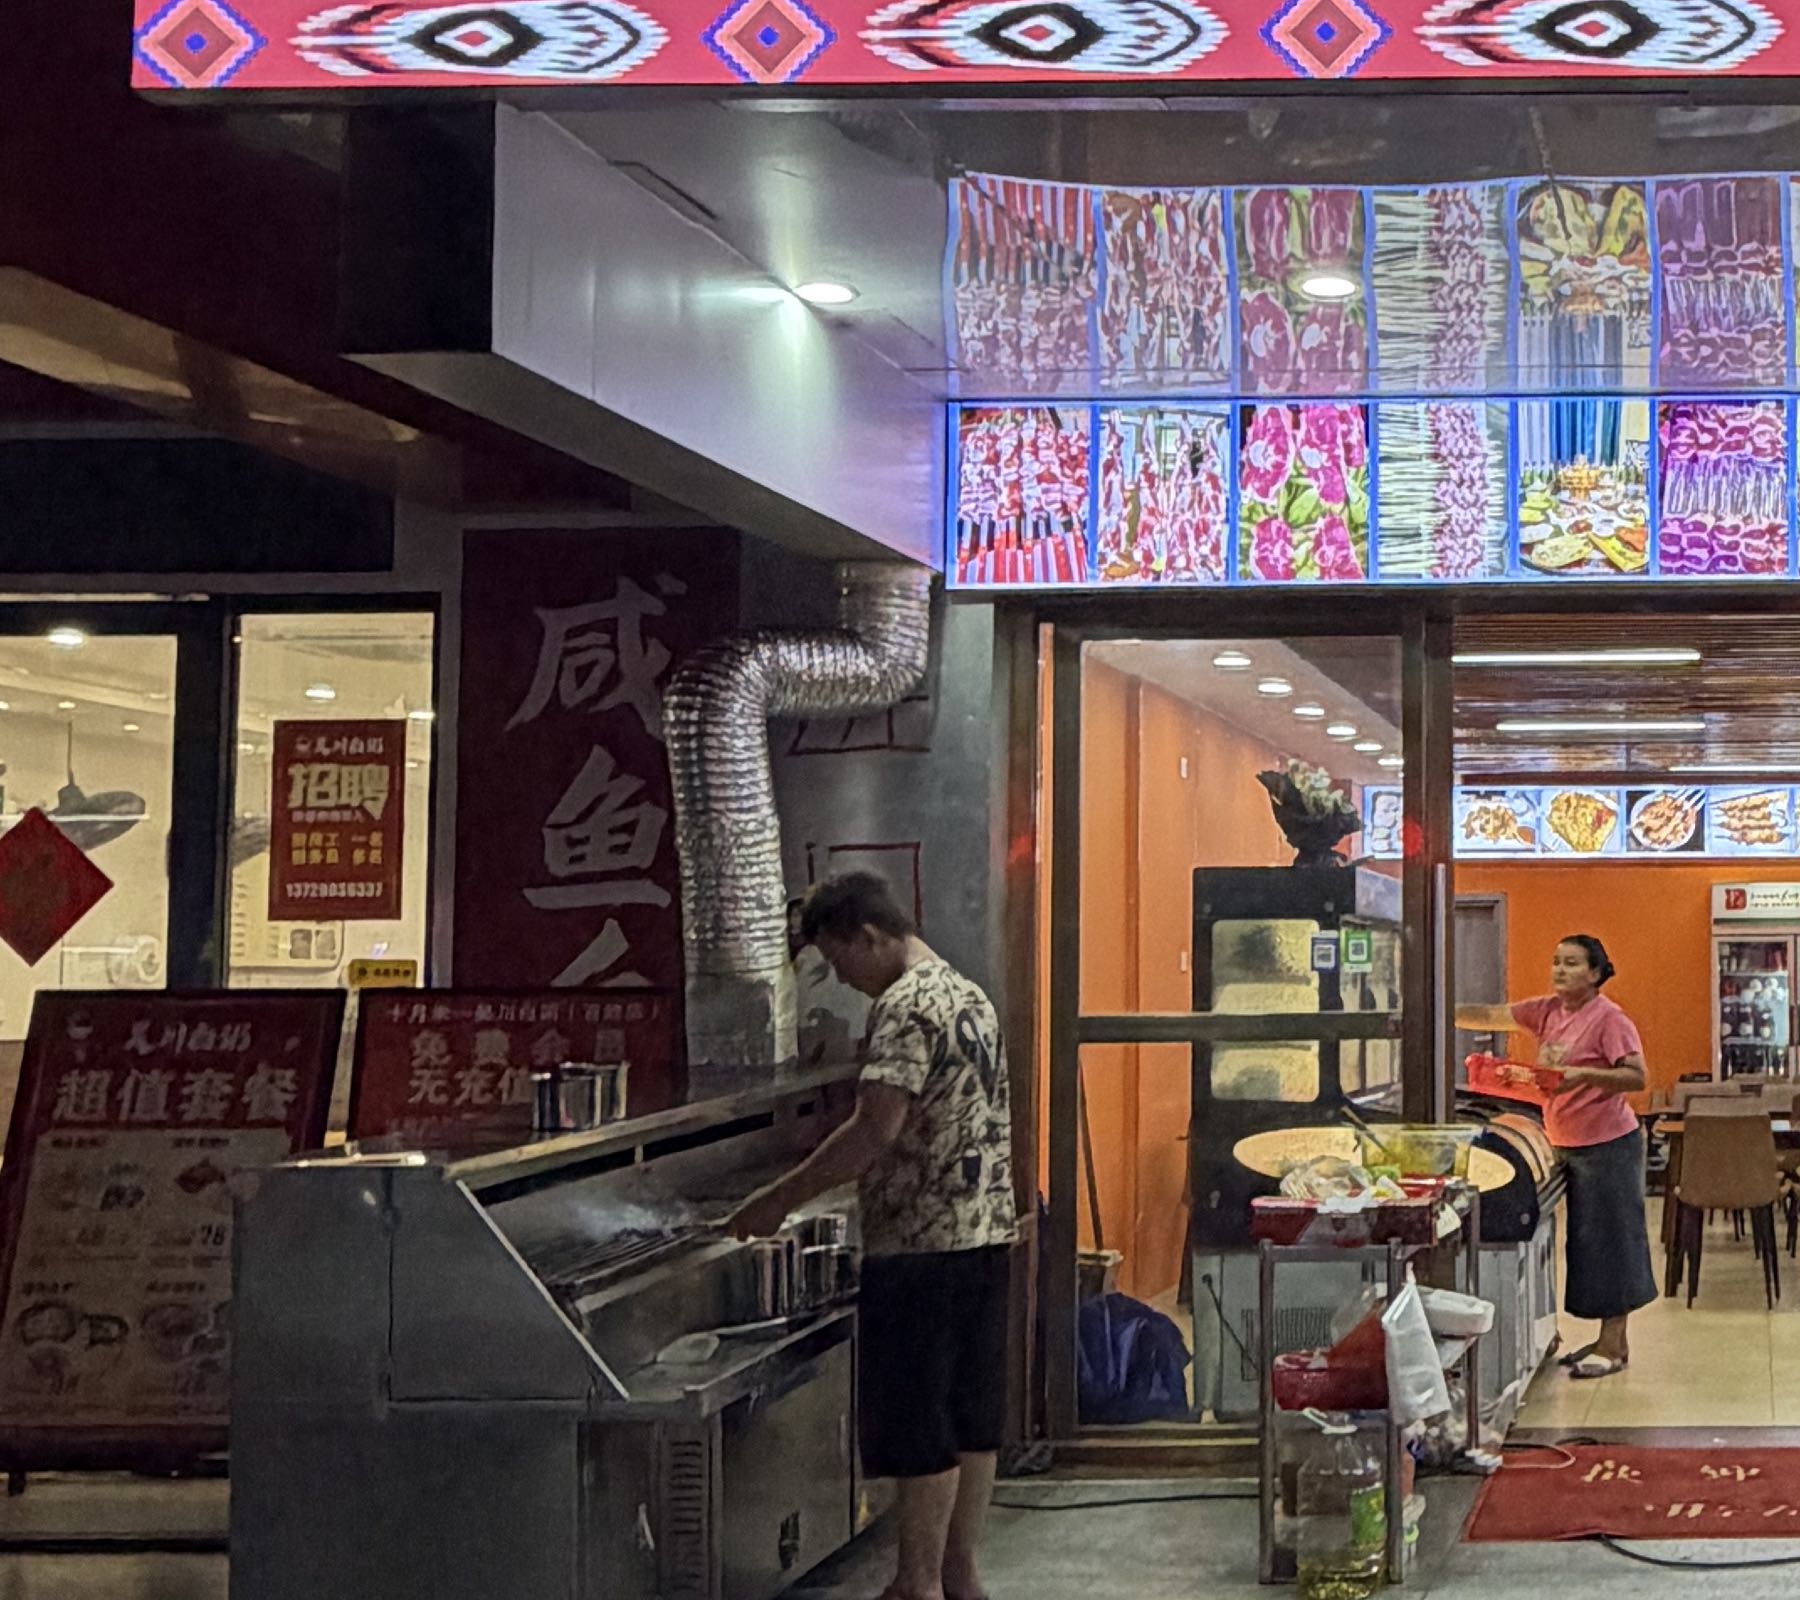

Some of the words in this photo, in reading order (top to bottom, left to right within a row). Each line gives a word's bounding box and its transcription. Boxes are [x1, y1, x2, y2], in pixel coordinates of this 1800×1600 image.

[287, 763, 390, 820] 招聘
[52, 1061, 299, 1124] 超值套餐
